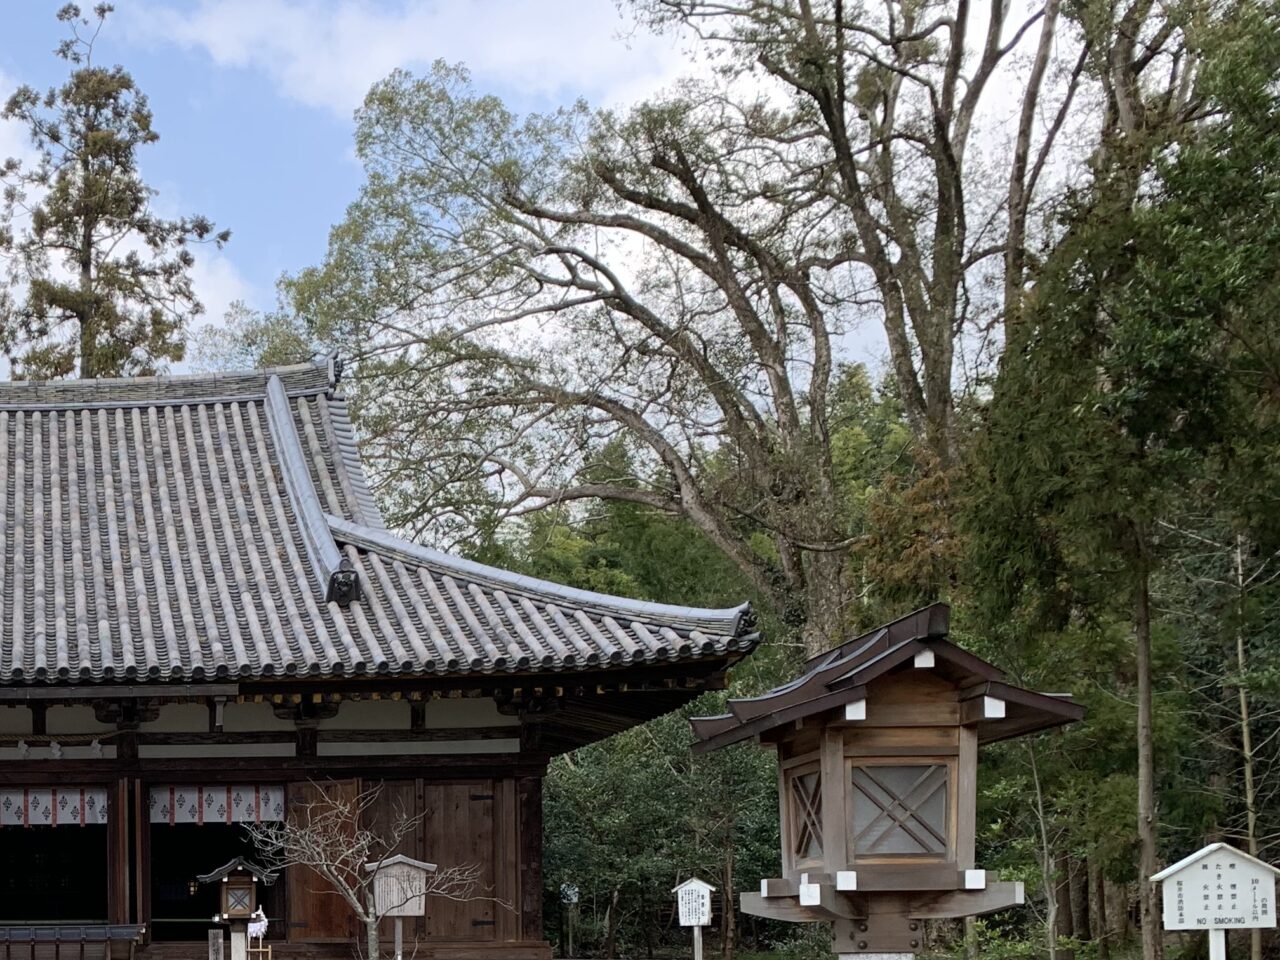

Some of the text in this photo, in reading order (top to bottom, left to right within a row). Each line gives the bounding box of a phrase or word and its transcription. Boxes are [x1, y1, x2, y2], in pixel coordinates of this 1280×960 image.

[1251, 878, 1259, 922] 10メートル以内
[1197, 917, 1246, 925] NO SMOKING
